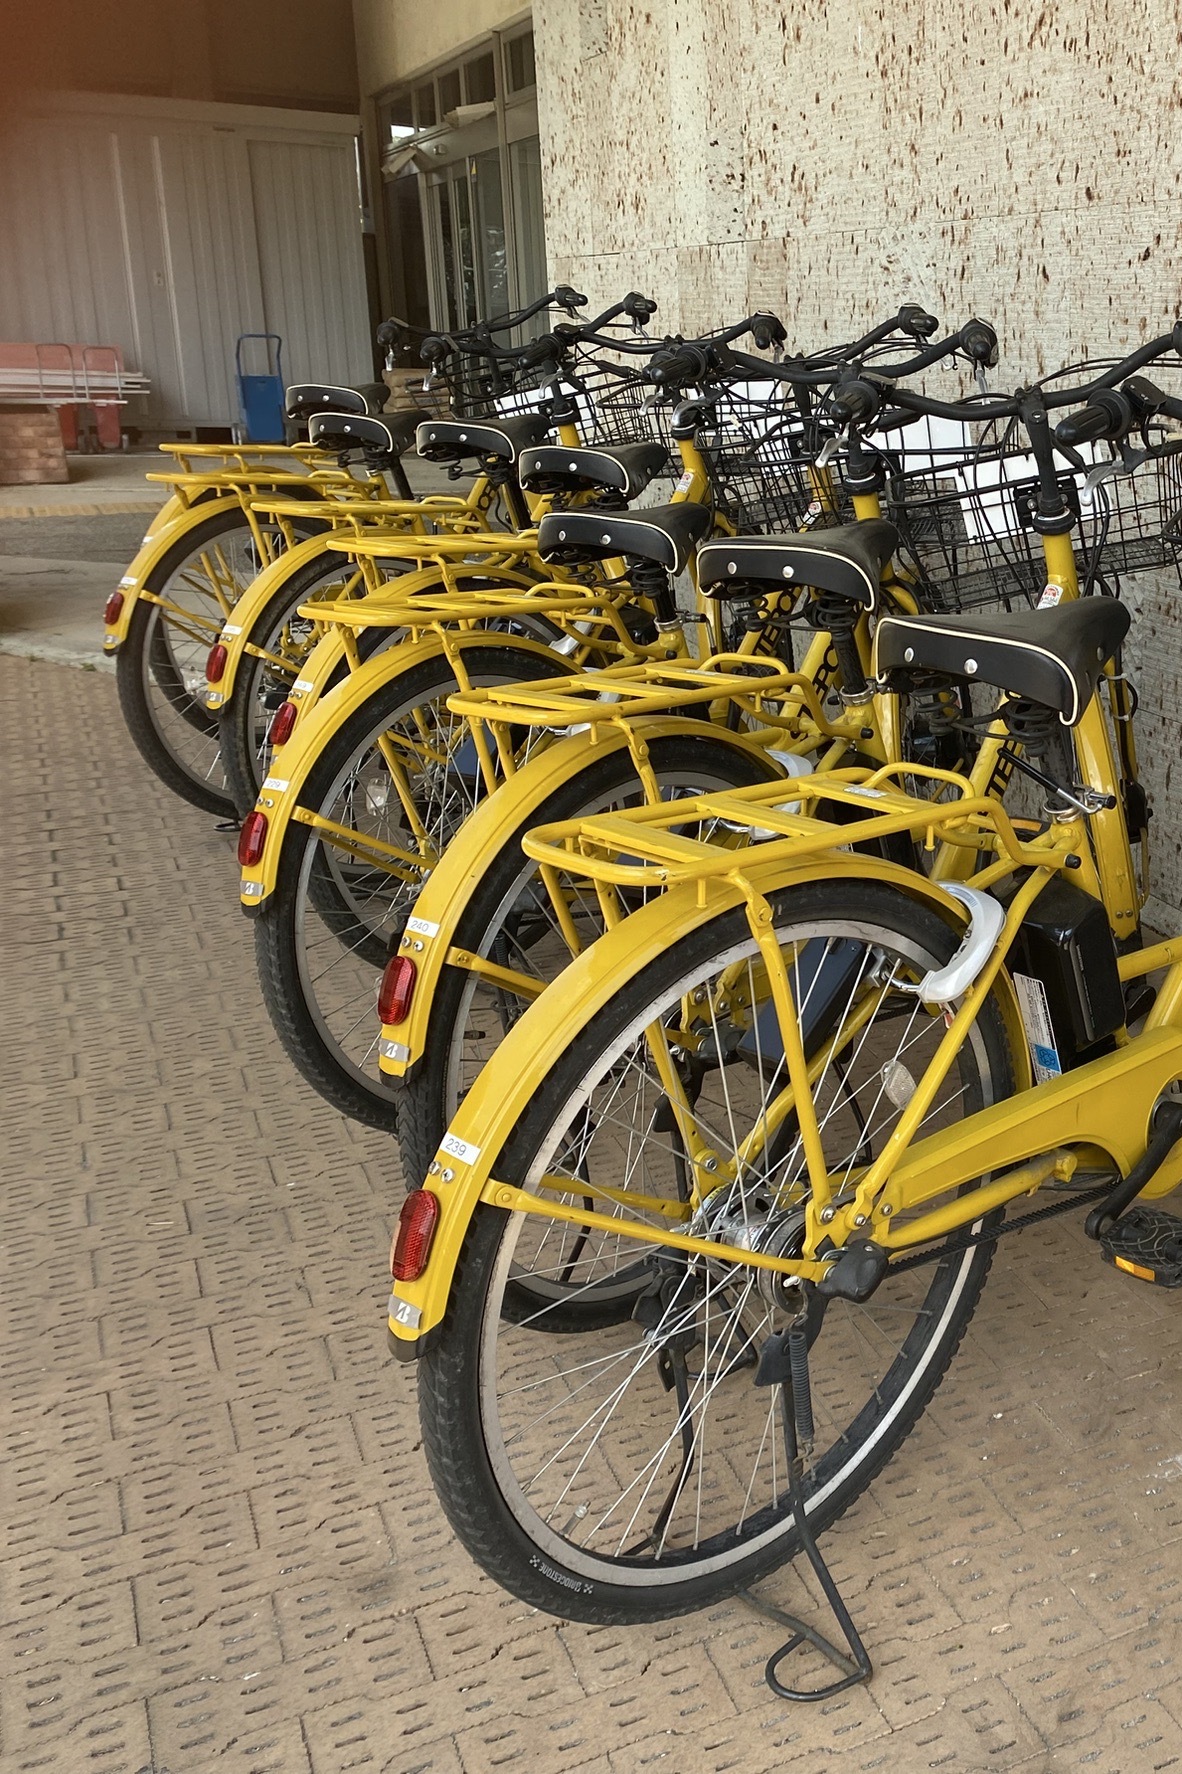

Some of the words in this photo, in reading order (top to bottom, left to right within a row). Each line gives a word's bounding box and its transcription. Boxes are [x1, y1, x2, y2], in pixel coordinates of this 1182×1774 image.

[410, 920, 429, 933] 240
[444, 1138, 467, 1157] 239
[538, 1562, 583, 1594] BRIDGESTONE
